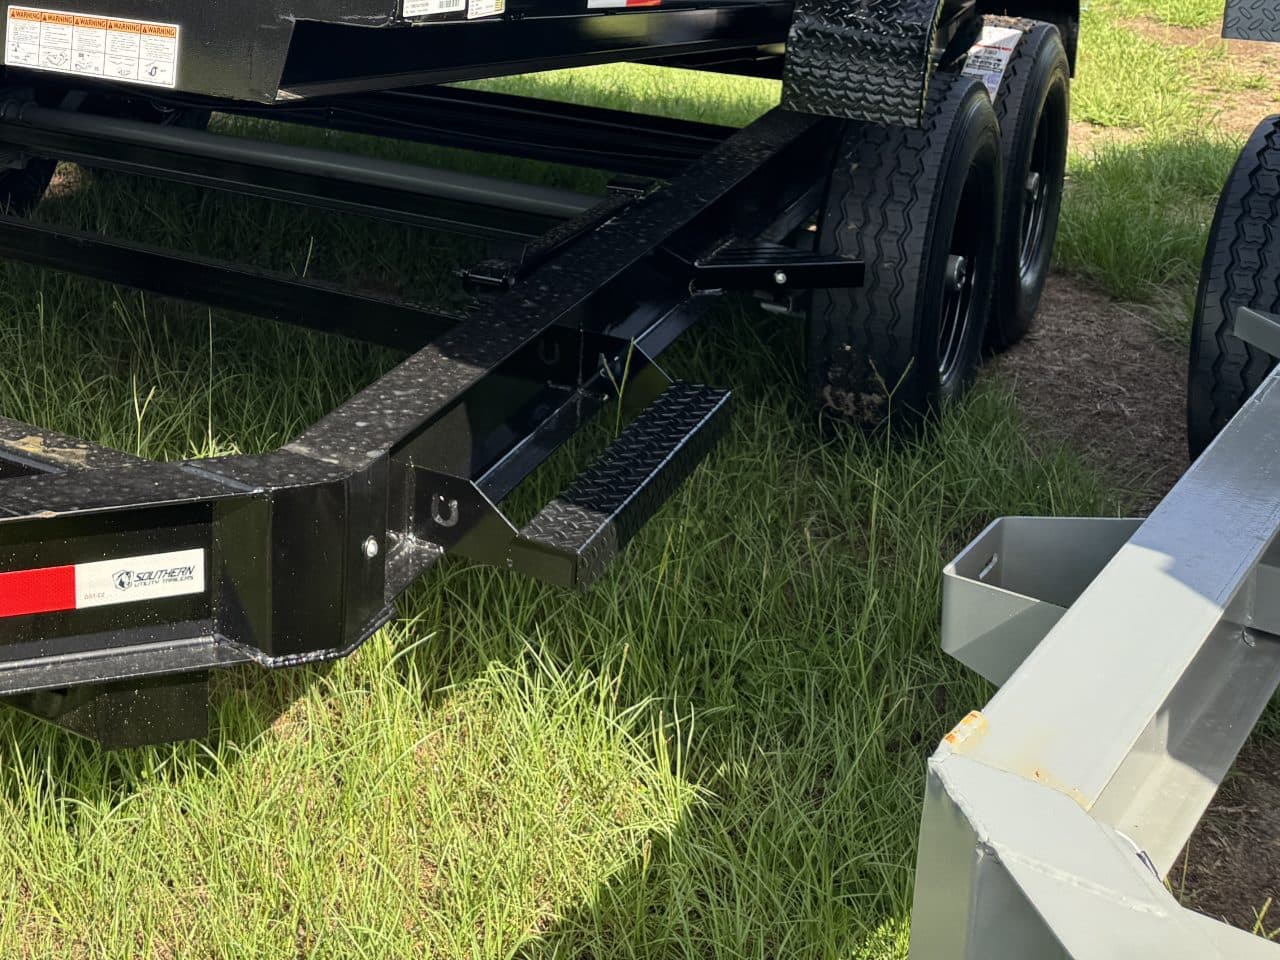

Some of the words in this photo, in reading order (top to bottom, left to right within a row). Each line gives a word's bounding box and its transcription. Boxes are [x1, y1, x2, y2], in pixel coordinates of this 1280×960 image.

[16, 10, 40, 20] WARNING
[47, 14, 73, 24] WARNING
[80, 18, 106, 28] WARNING
[113, 22, 140, 32] WARNING
[148, 25, 175, 36] WARNING
[133, 565, 196, 582] SOUTHERN
